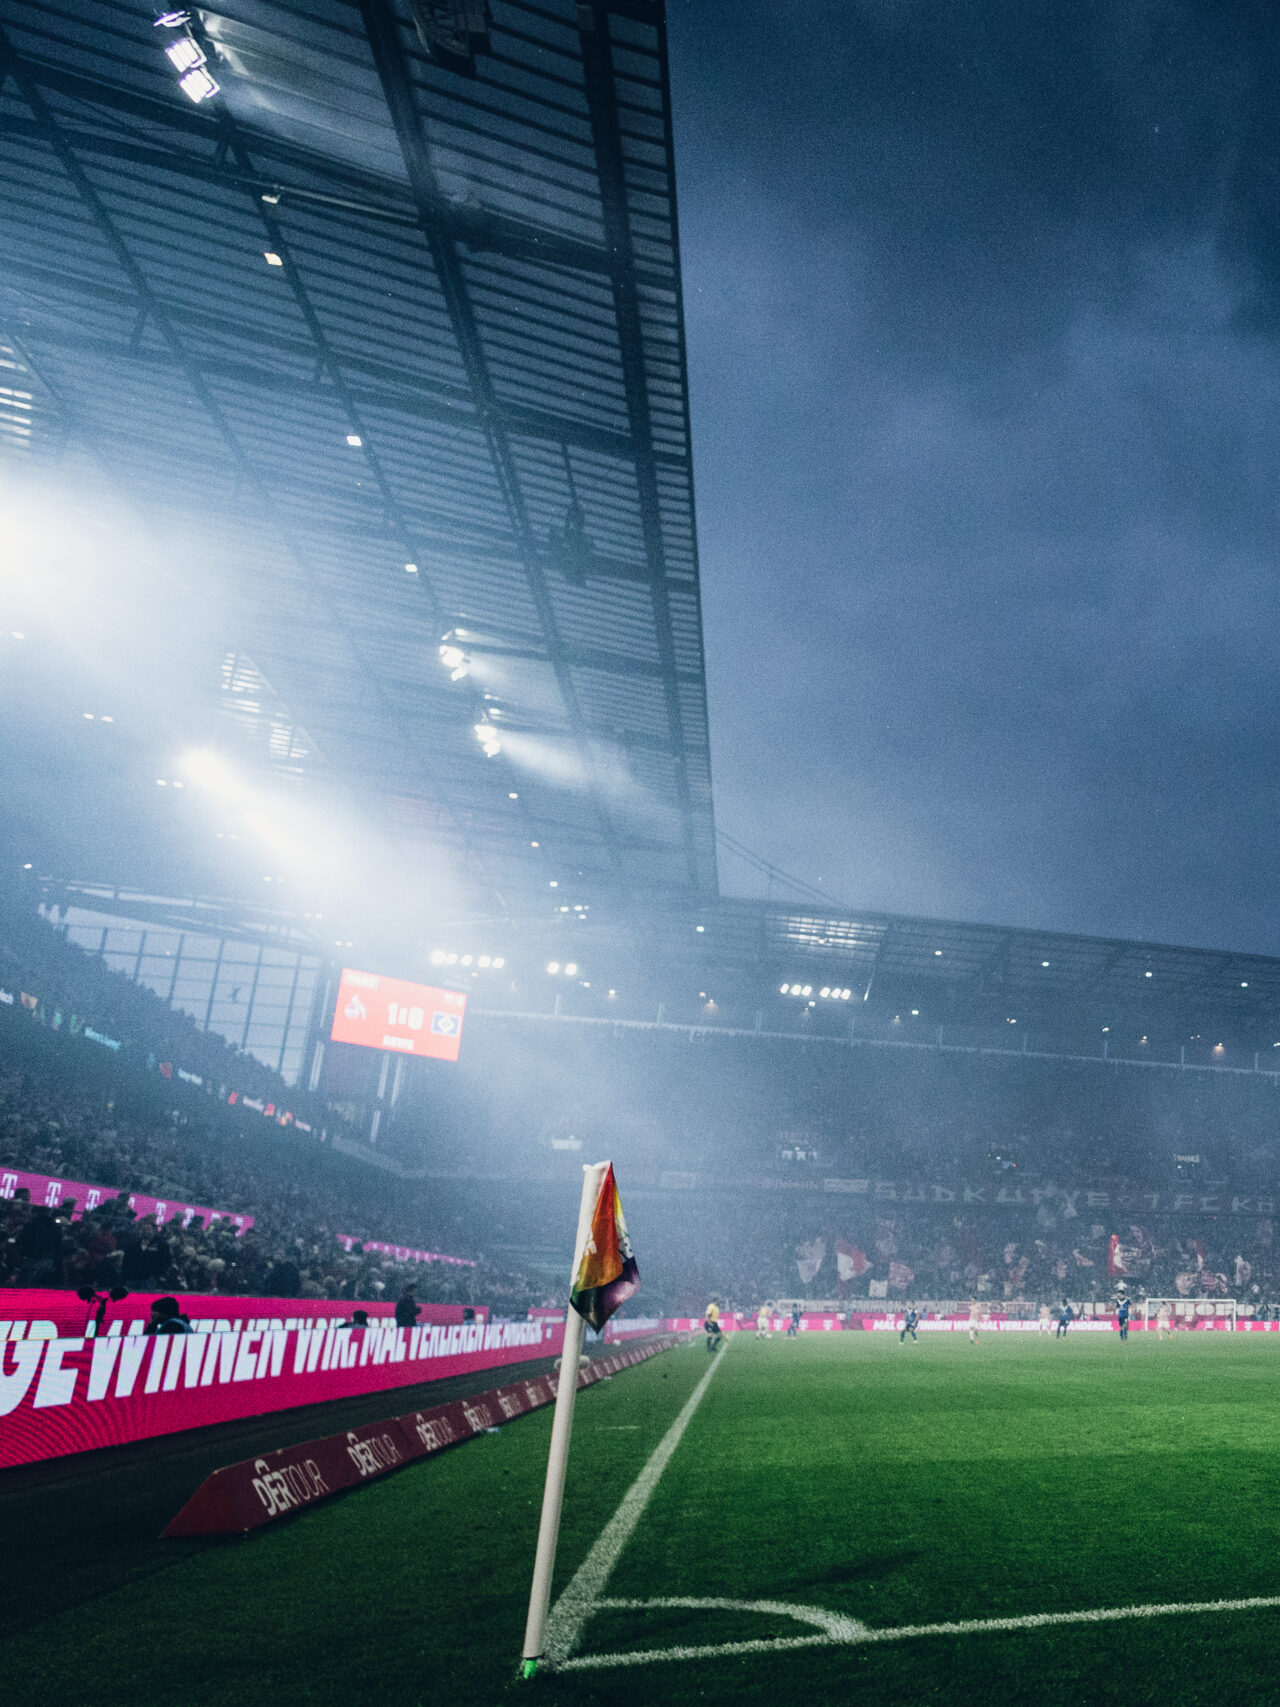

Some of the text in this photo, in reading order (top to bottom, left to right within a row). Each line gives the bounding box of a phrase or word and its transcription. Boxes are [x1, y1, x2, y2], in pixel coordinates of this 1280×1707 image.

[388, 1002, 424, 1030] 1:0
[360, 1327, 407, 1366] MAL
[347, 1432, 403, 1476] DERTOUR
[251, 1459, 331, 1516] DERTOUR
